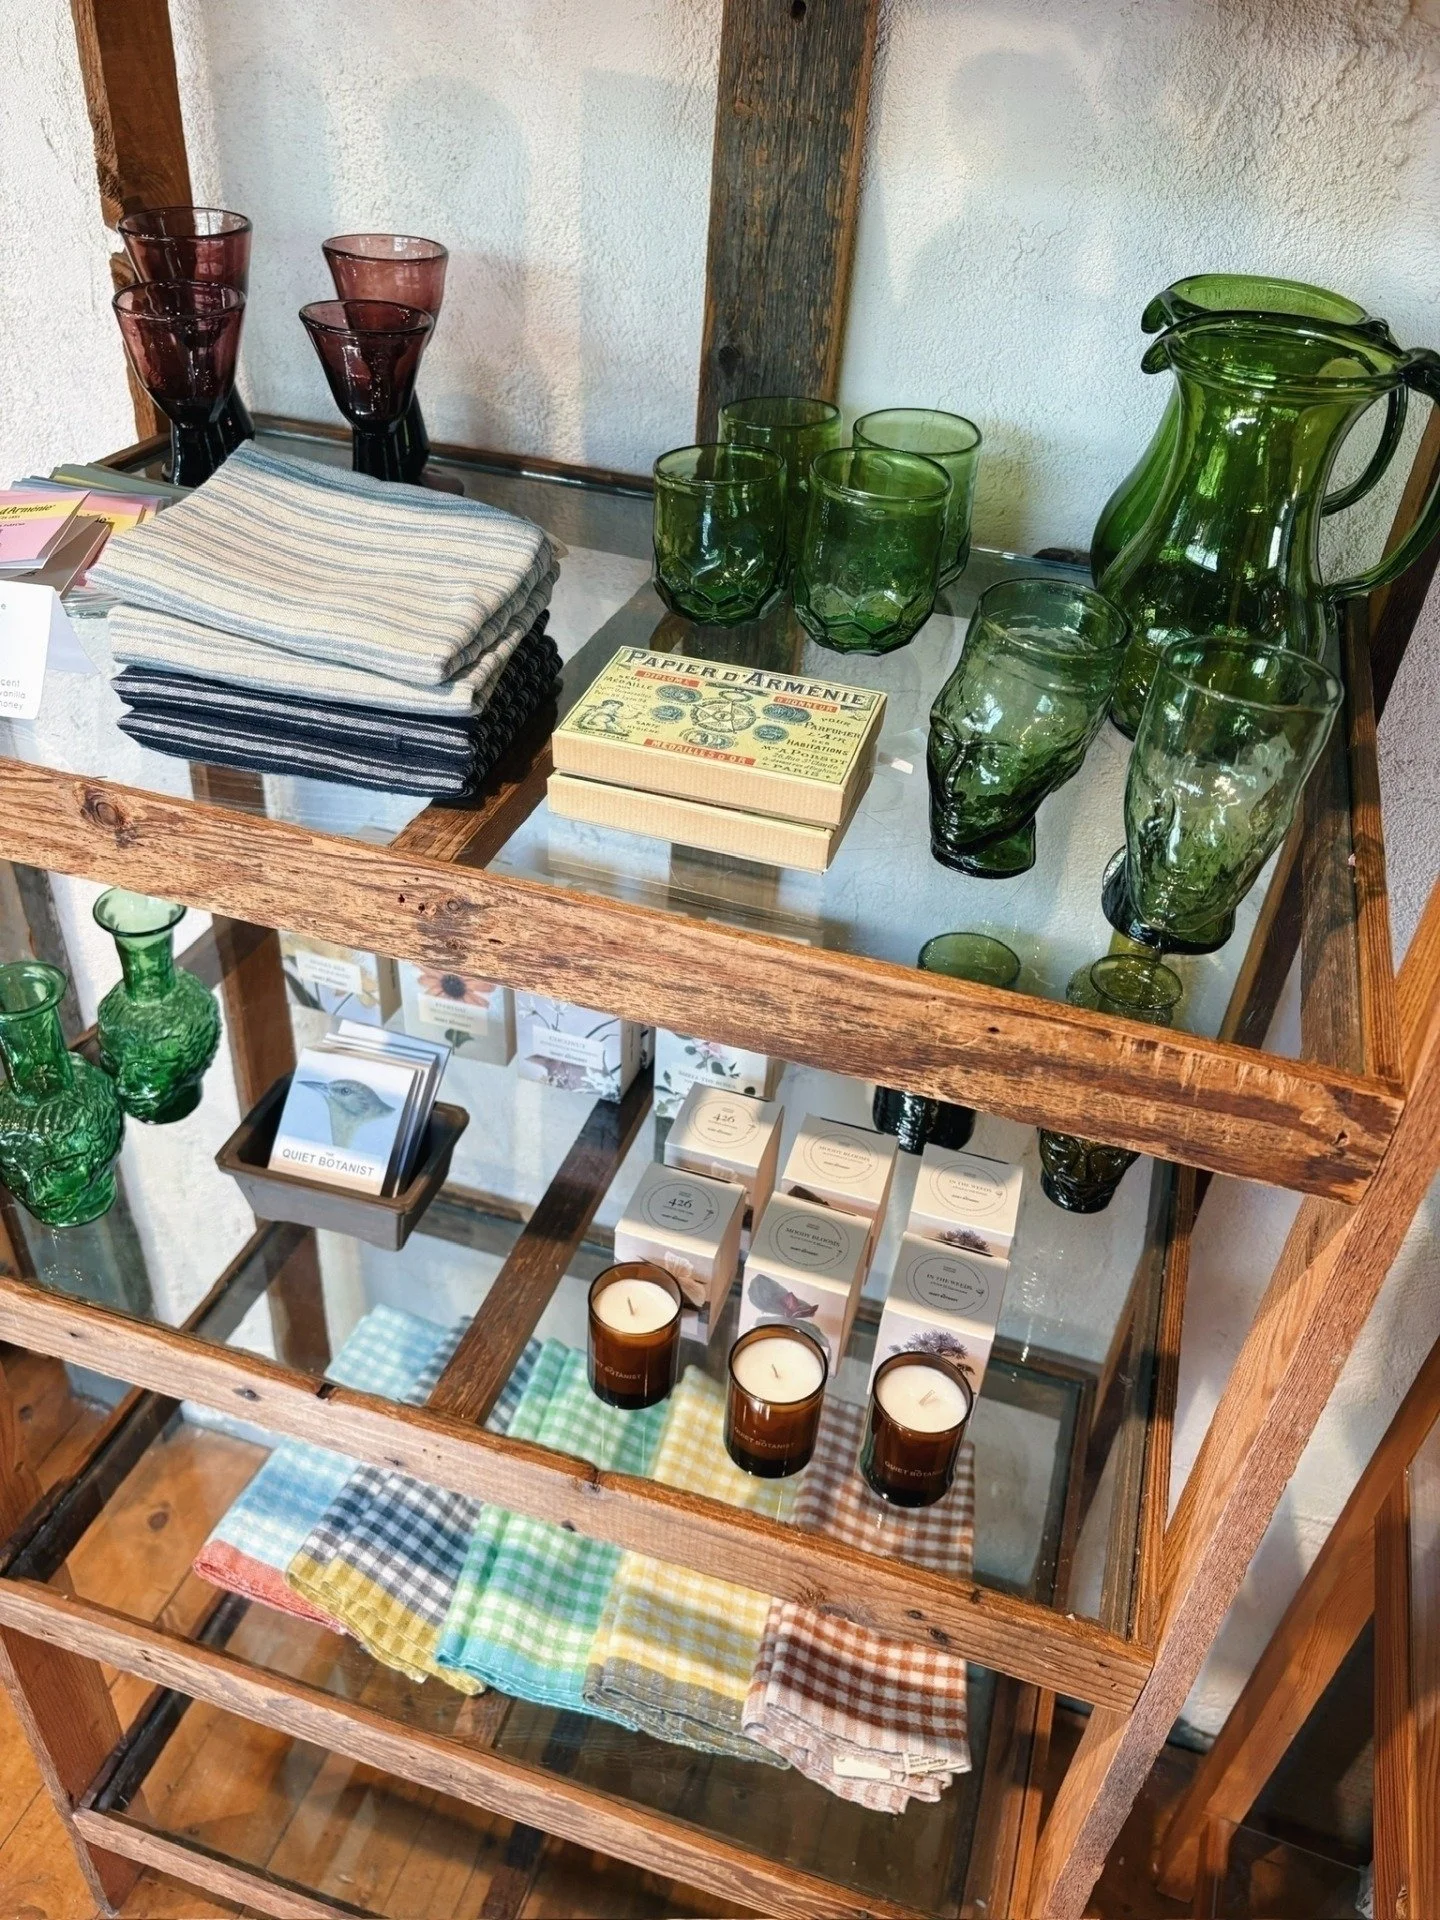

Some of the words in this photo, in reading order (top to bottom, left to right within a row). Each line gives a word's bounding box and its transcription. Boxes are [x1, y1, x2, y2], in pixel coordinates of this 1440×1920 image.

[625, 649, 717, 678] PAPIER
[804, 721, 861, 739] PARFUMER
[786, 739, 849, 756] HABITATIONS
[773, 763, 819, 777] PARIS
[712, 1113, 735, 1124] 426
[282, 1148, 316, 1163] QUIET
[318, 1156, 374, 1176] BOTANIST
[668, 1198, 692, 1209] 426
